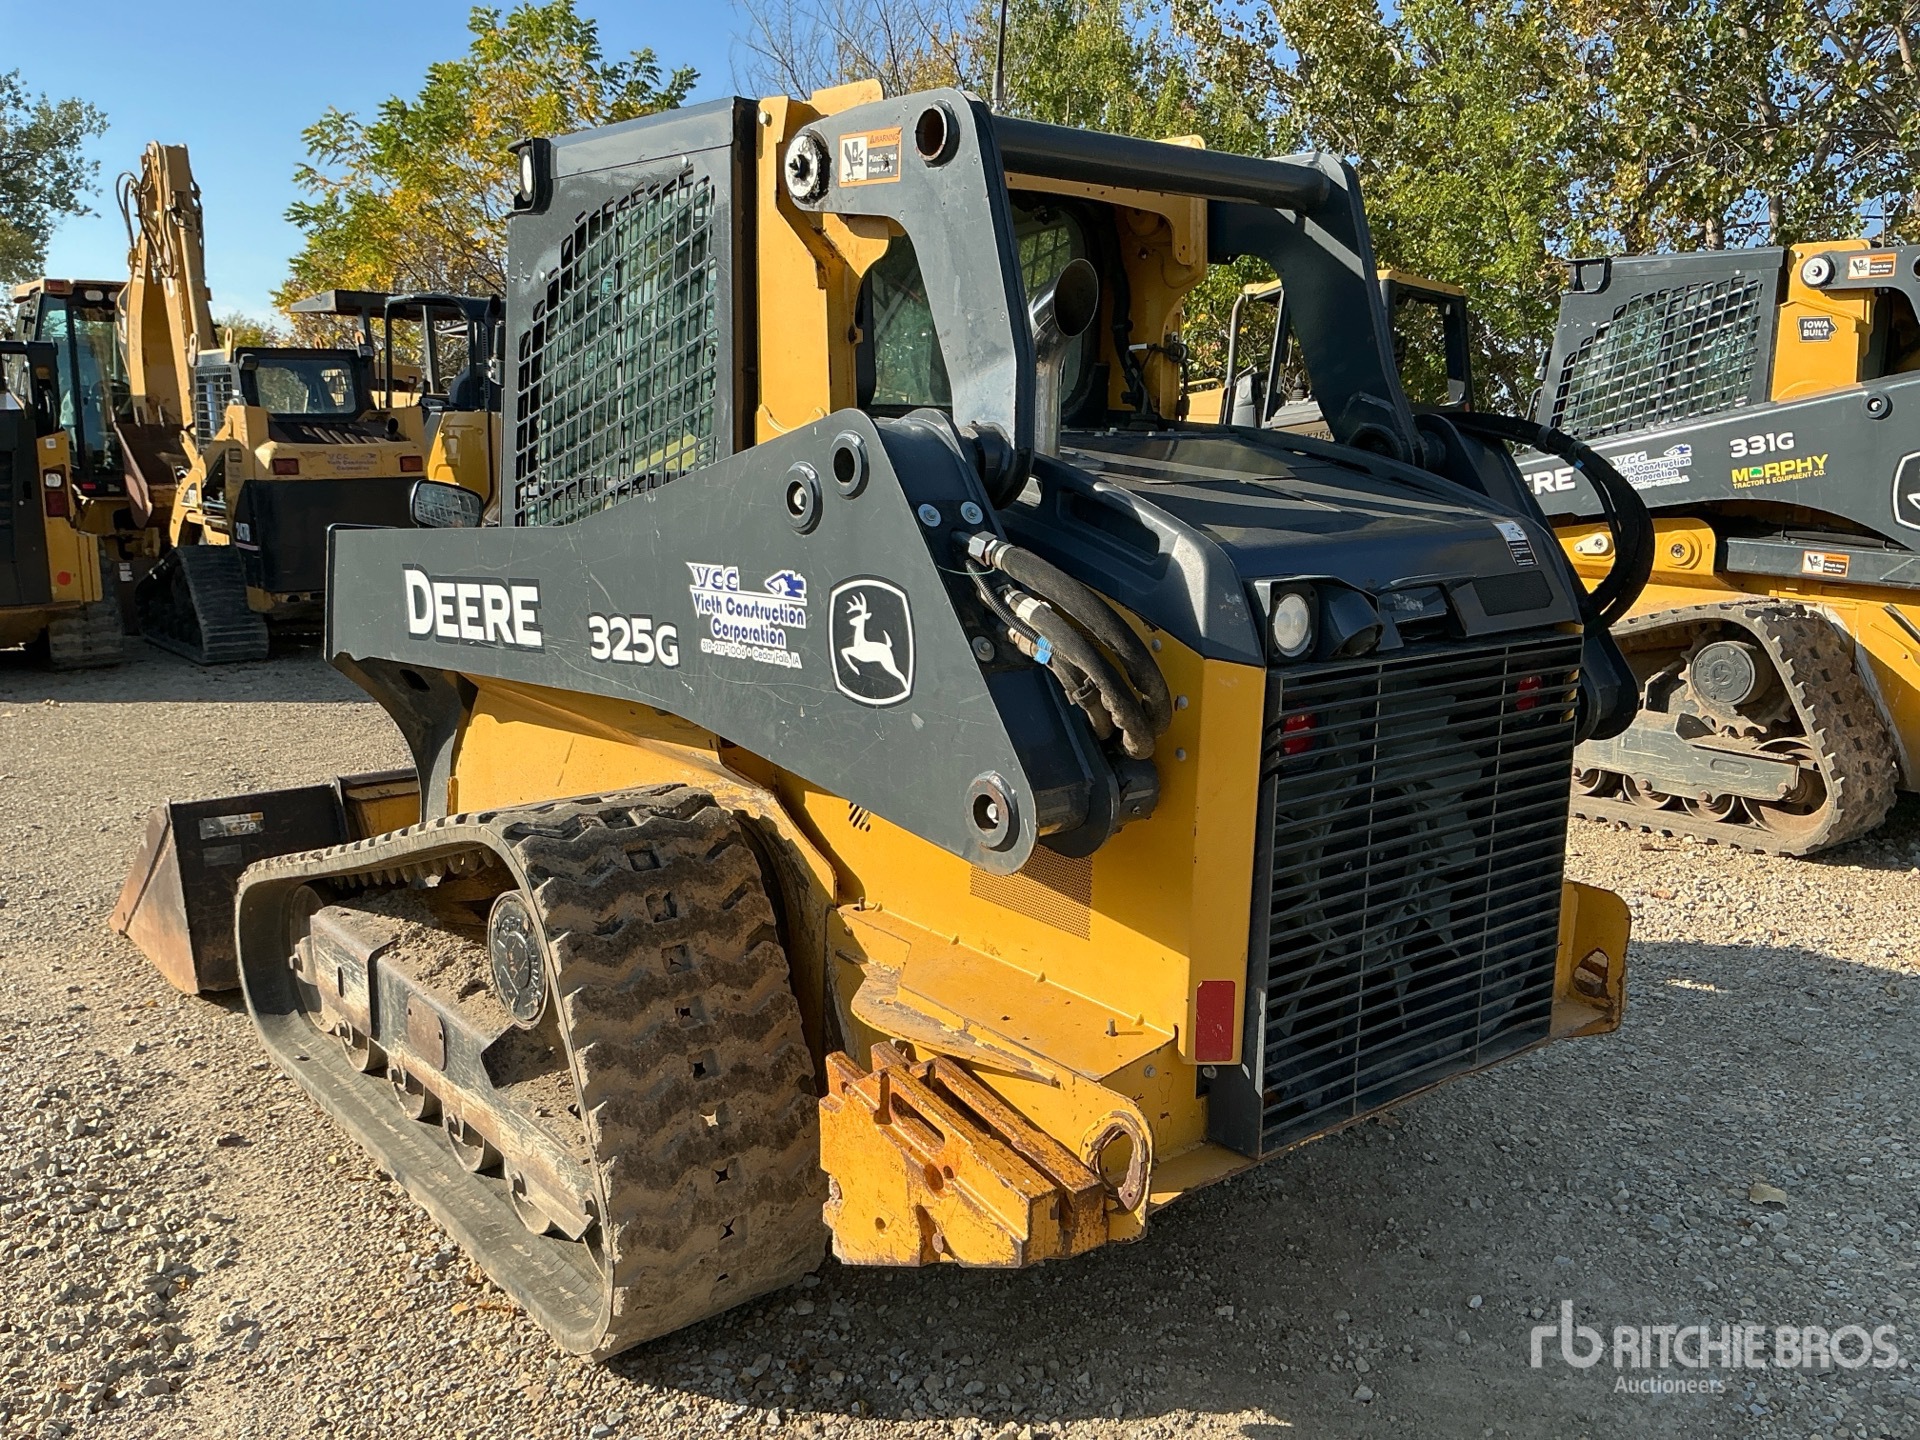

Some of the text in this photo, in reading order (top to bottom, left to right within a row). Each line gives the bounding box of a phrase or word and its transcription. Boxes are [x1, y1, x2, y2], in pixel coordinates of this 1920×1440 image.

[1803, 321, 1829, 329] IOWA
[1803, 329, 1829, 337] BUILT
[1729, 431, 1795, 458] 331G
[1628, 470, 1678, 483] Corporation
[1637, 458, 1691, 472] Construction
[1733, 480, 1764, 489] TRACTOR
[1772, 472, 1812, 484] EQUIPMENT
[691, 565, 739, 591] VCC
[403, 567, 544, 649] DEERE
[694, 593, 804, 625] Vieth Construction
[587, 614, 680, 667] 325G
[712, 618, 785, 646] Corporation
